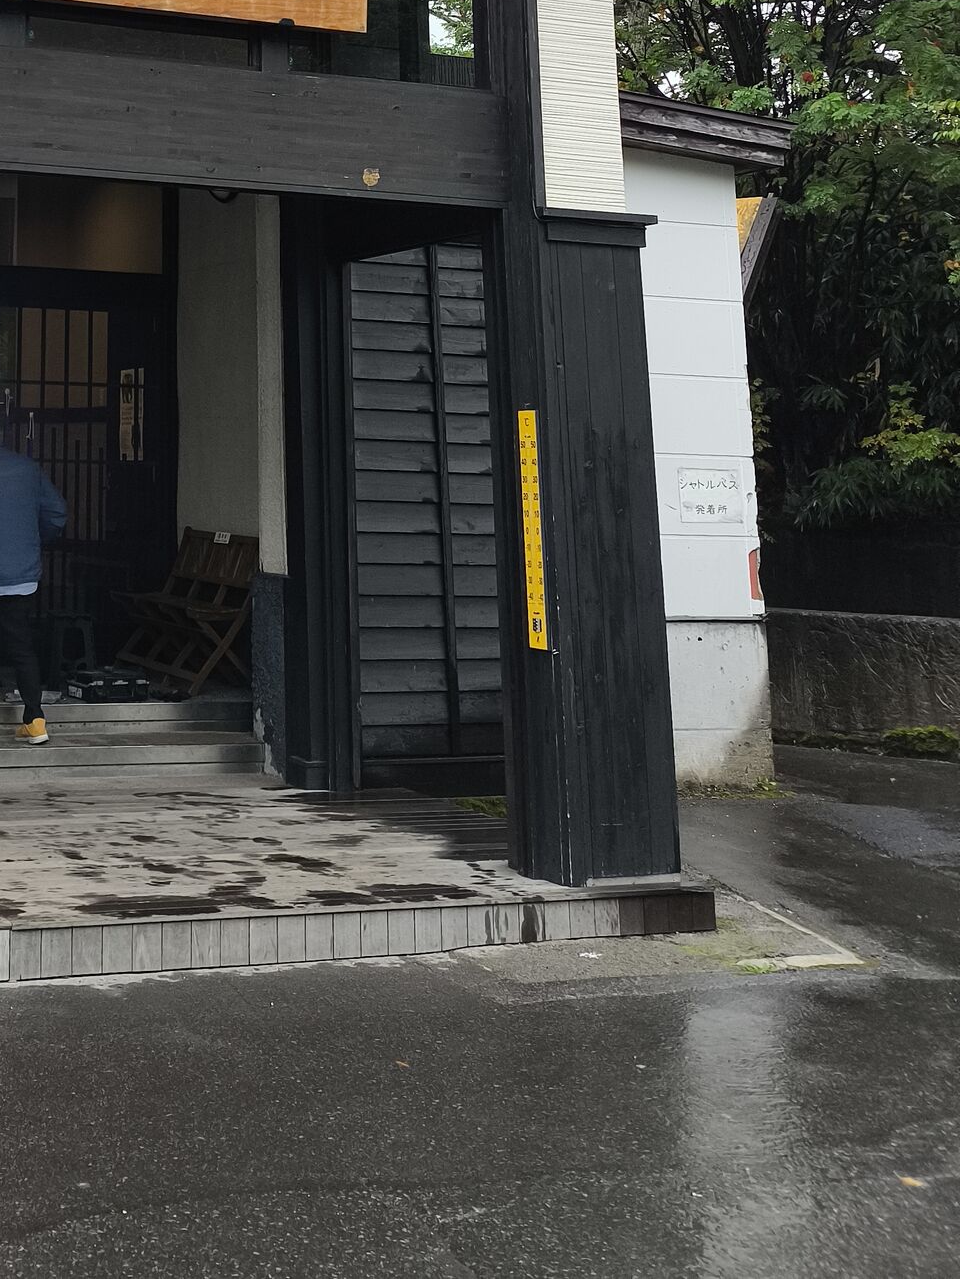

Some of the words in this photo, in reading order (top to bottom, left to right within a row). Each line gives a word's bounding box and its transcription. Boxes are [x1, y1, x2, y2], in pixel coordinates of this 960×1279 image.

[679, 477, 738, 490] シャトルバス
[695, 504, 728, 515] 発着所
